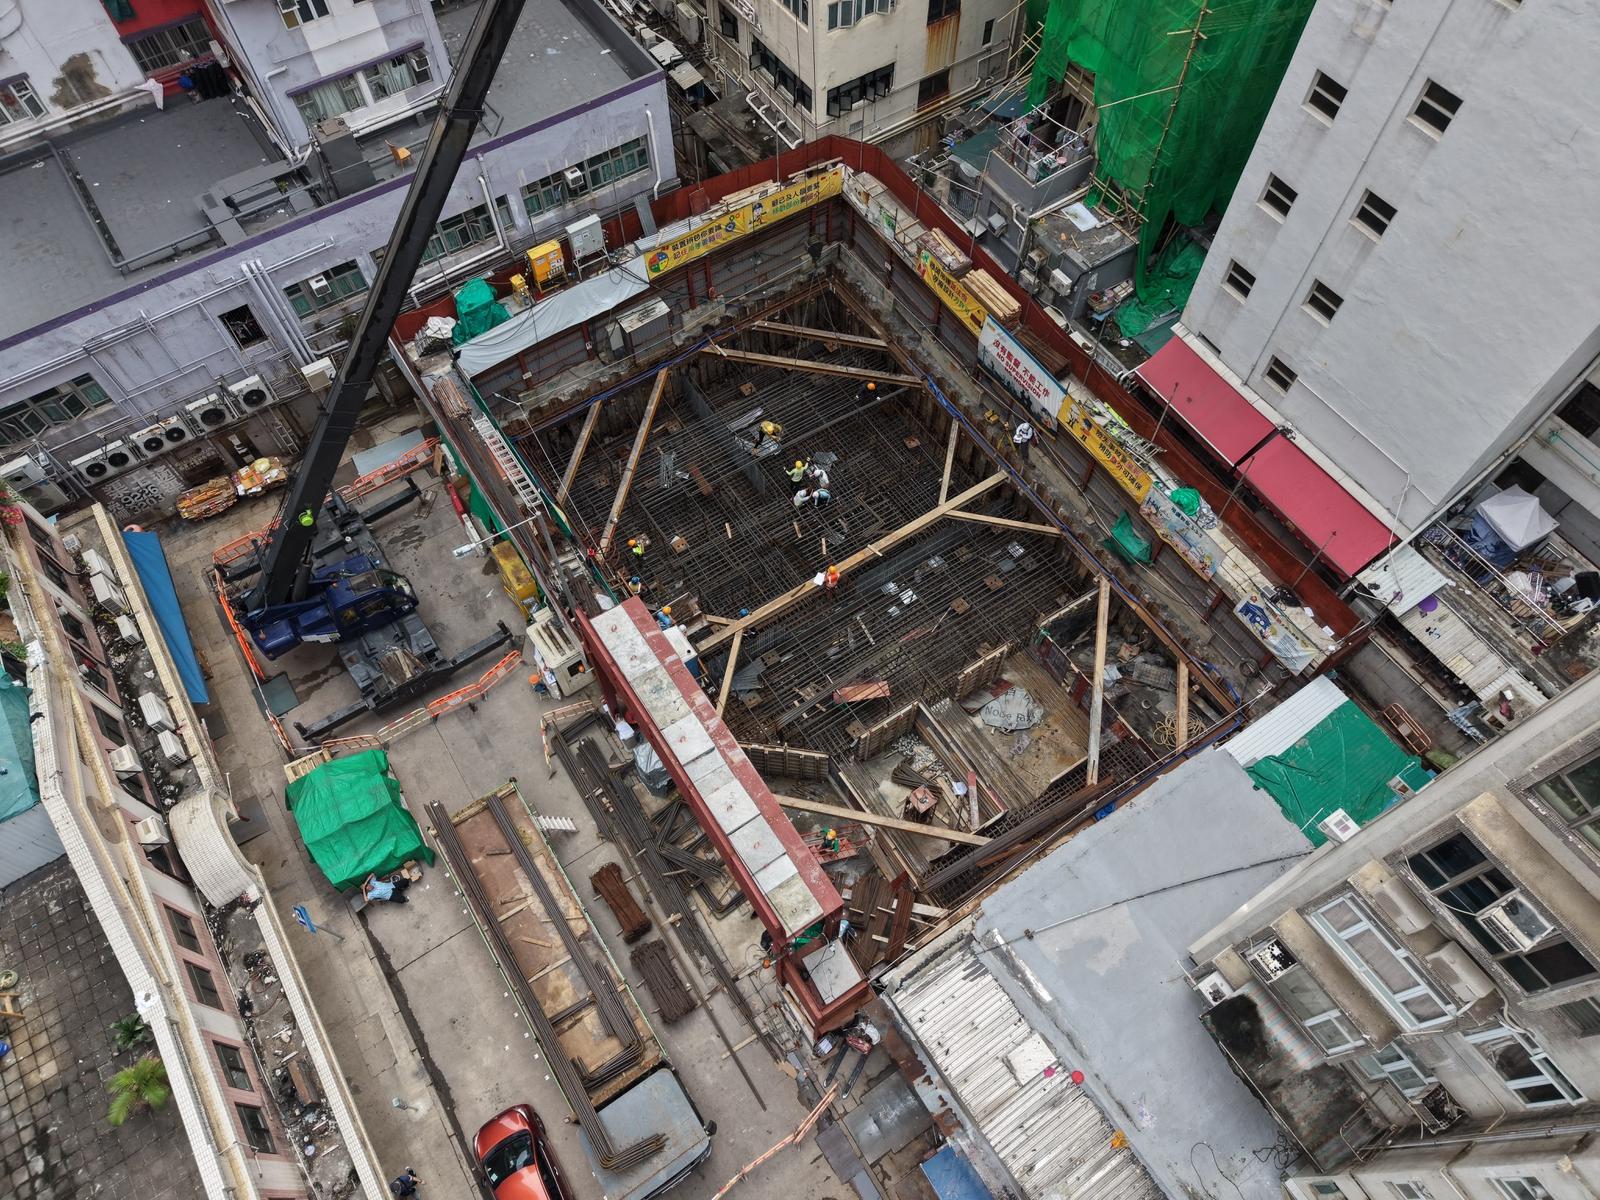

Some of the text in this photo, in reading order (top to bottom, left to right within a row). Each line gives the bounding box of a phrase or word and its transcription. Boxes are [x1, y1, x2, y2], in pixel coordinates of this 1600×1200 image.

[1004, 359, 1041, 398] SUPERVISION
[1022, 365, 1050, 399] 不能工作
